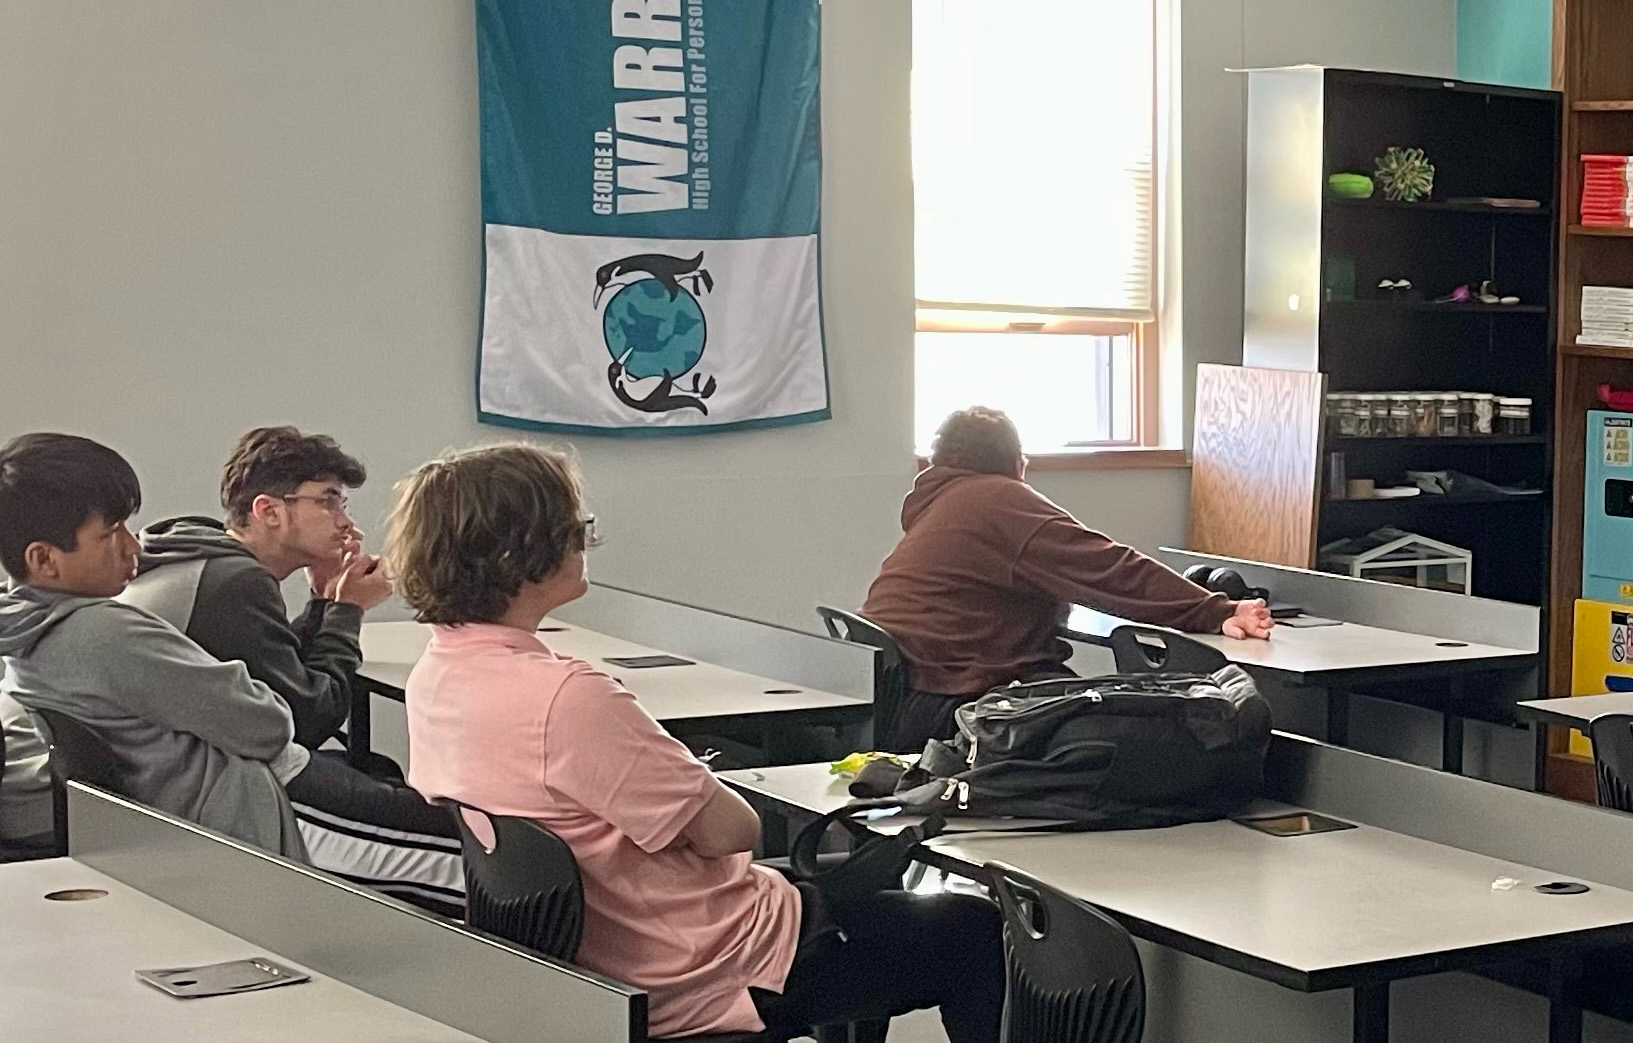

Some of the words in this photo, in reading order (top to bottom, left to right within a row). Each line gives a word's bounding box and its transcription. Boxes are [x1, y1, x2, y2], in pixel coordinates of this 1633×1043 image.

[689, 64, 707, 93] For
[611, 0, 689, 214] WARR
[690, 98, 709, 163] School
[594, 127, 613, 144] D.
[592, 147, 613, 214] GEORGE
[692, 167, 711, 210] High
